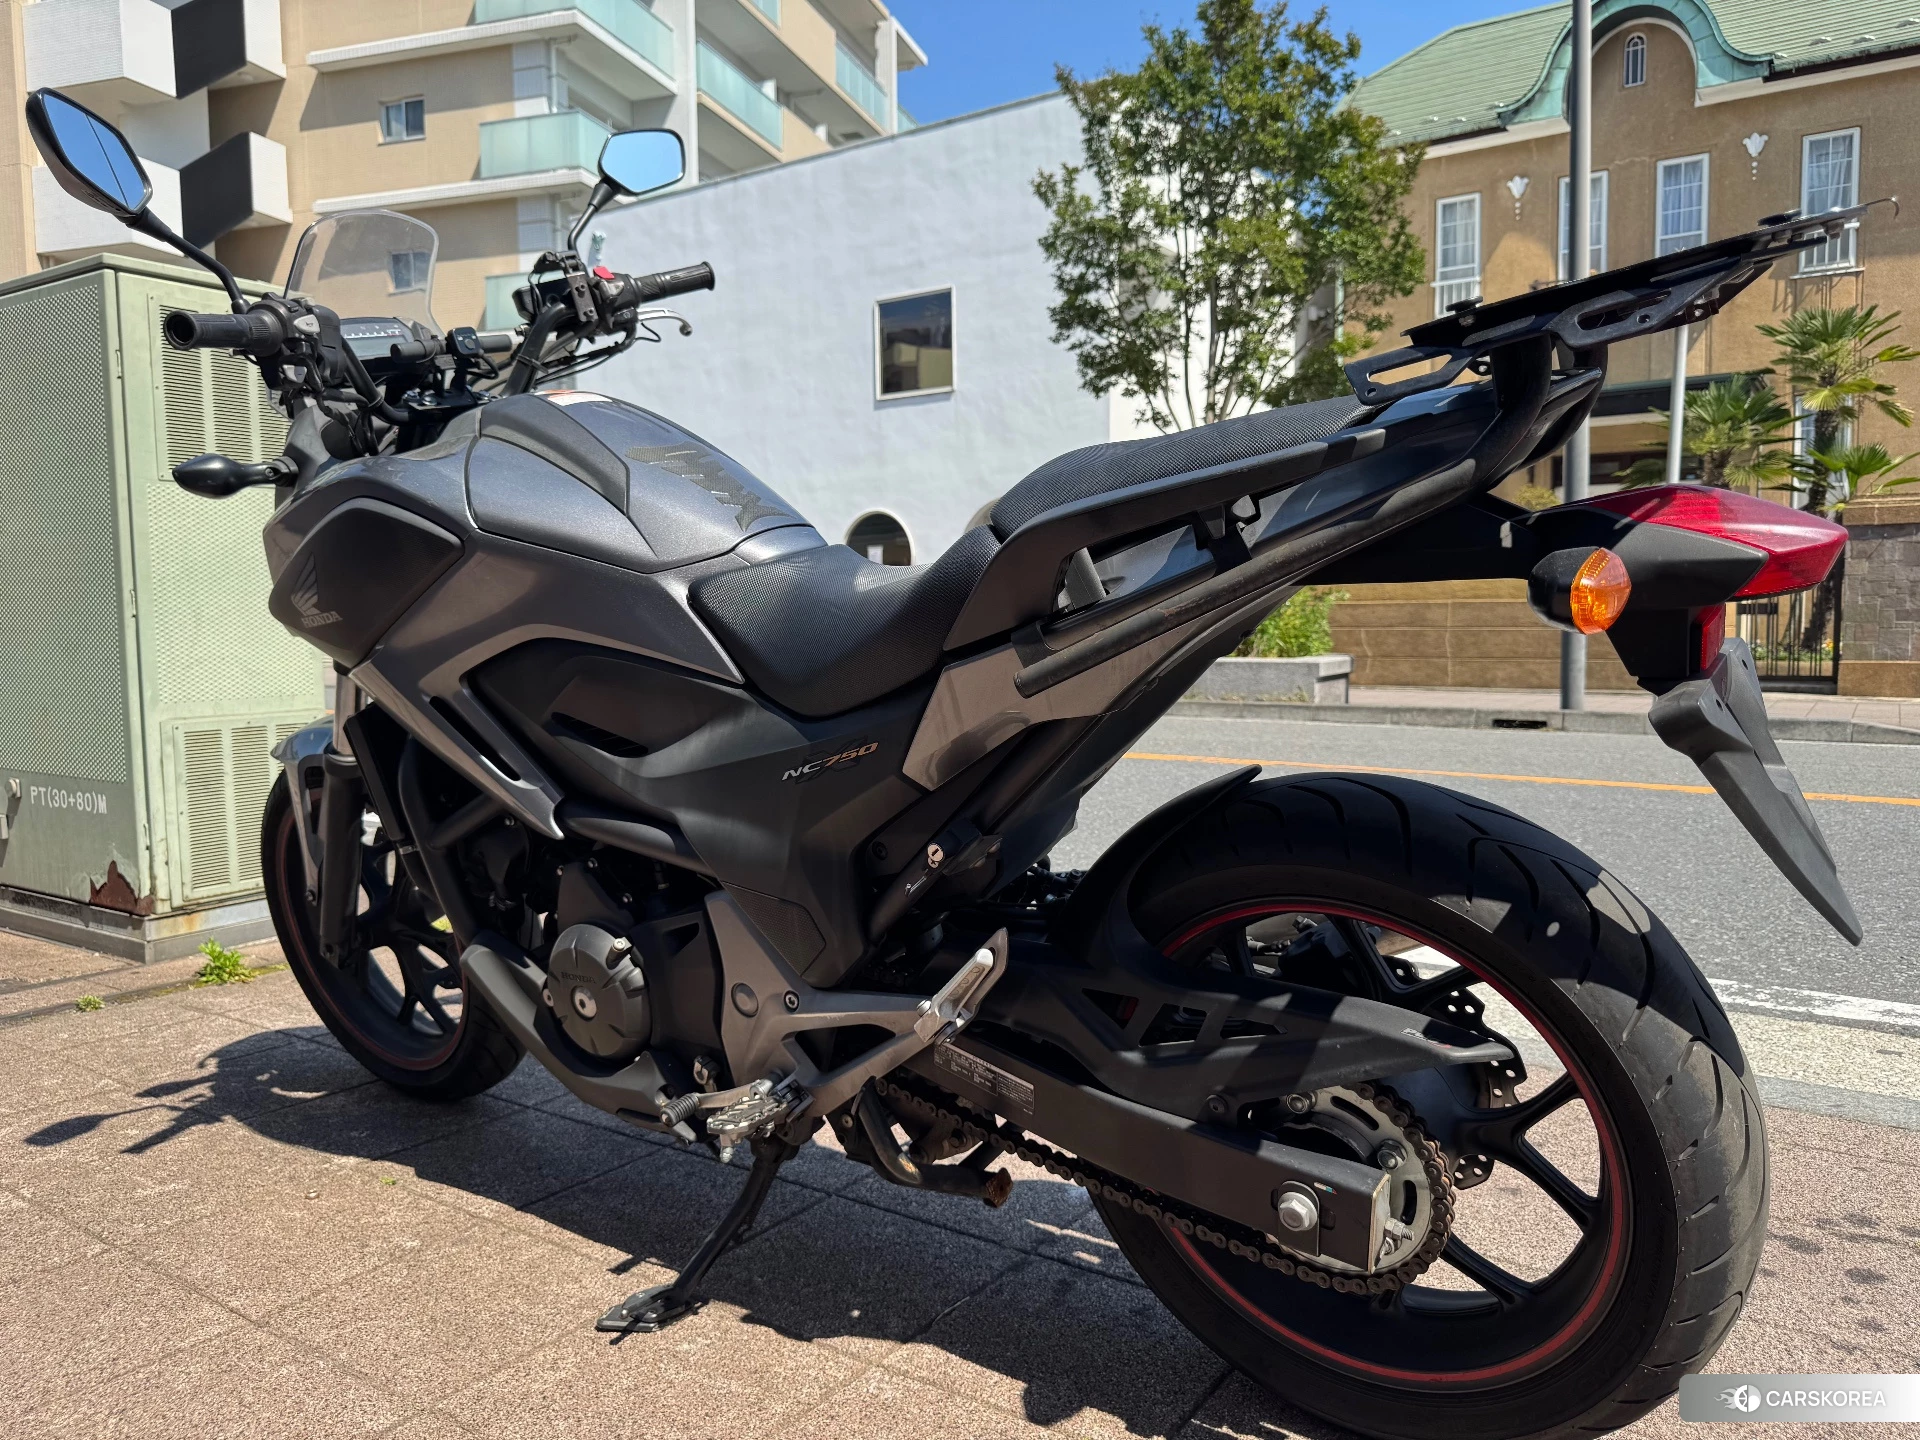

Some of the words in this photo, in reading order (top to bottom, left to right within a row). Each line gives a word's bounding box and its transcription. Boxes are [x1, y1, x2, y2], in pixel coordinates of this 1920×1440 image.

[301, 611, 343, 628] HONDA
[781, 742, 879, 781] NC750
[30, 785, 107, 814] PT(30+80)M
[561, 971, 597, 984] HONDA
